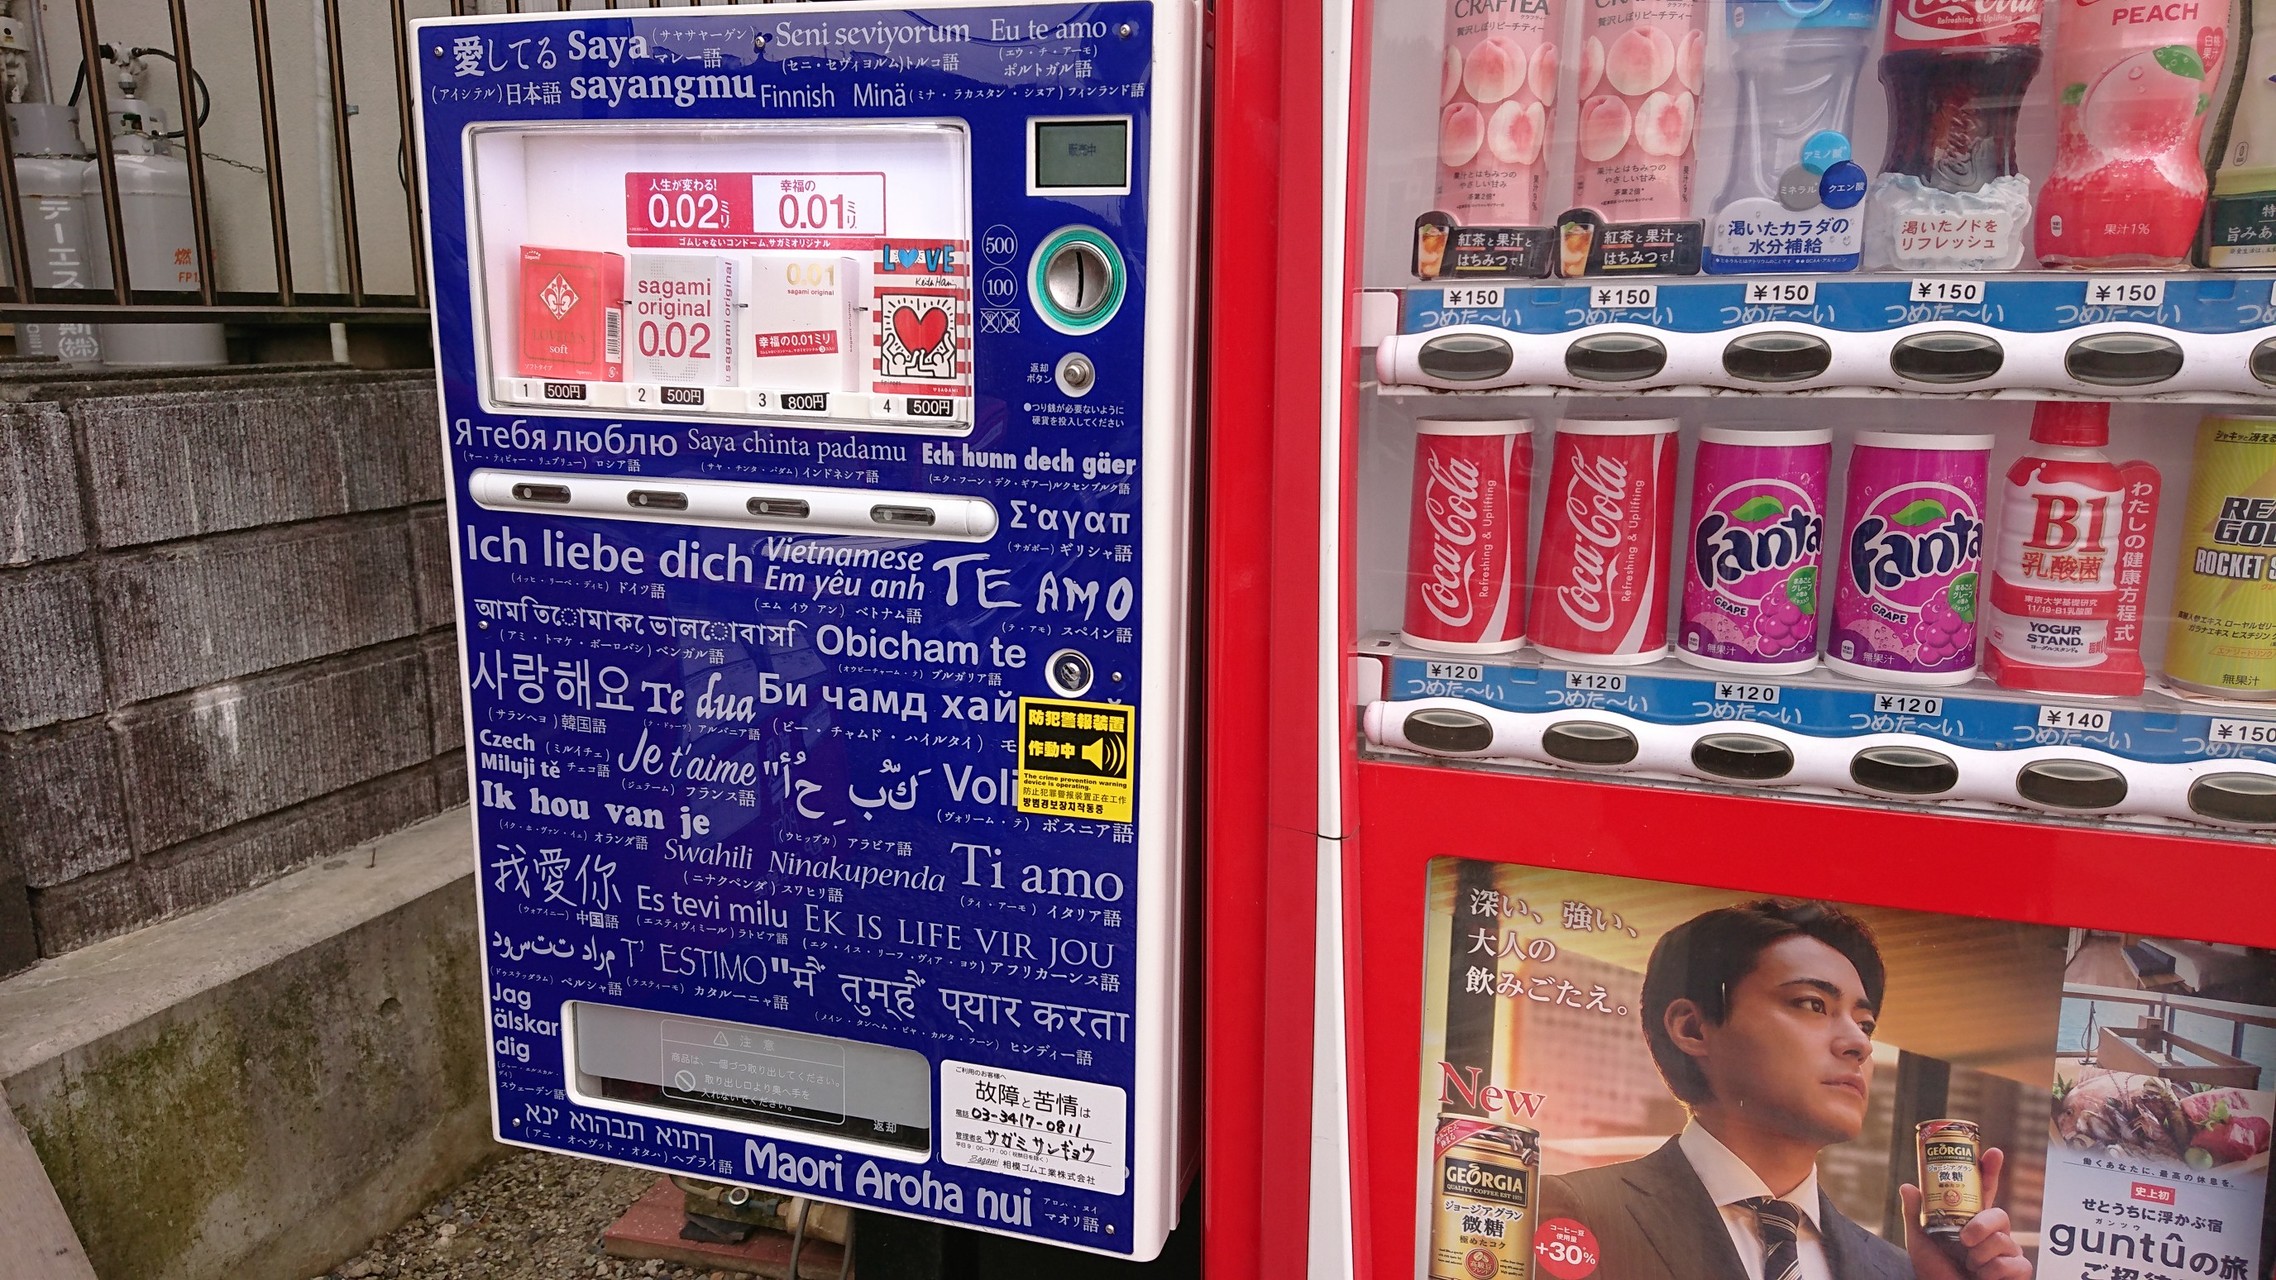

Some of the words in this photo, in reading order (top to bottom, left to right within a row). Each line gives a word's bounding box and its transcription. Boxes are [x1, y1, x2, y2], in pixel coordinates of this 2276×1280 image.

[2111, 3, 2199, 27] PEACH
[775, 22, 837, 48] Seni
[843, 22, 971, 54] seviyorum
[990, 19, 1022, 42] Eu
[1028, 22, 1050, 42] te
[1055, 19, 1107, 41] amo
[453, 36, 557, 77] 愛してる
[568, 30, 649, 68] Saya
[655, 47, 723, 69] マレー語
[1003, 59, 1093, 79] ポルトガル語
[570, 73, 756, 107] sayangmu
[761, 84, 835, 108] Finnish
[853, 83, 906, 108] Minä
[780, 179, 816, 193] 幸福の
[648, 193, 719, 229] 0.02
[778, 193, 844, 229] 0.01
[1603, 229, 1684, 246] 紅茶と果汁と
[1901, 219, 1999, 234] 渇いたノドを
[2103, 223, 2151, 236] 果汁1%
[985, 236, 1015, 255] 500
[1457, 232, 1534, 248] 紅茶と果汁と
[1748, 238, 1824, 255] 水分補給
[1901, 237, 1996, 252] リフレッシュ
[786, 263, 836, 288] 0.01
[638, 277, 712, 298] sagami
[986, 278, 1014, 297] 100
[1448, 288, 1500, 306] ¥150
[1597, 288, 1652, 306] ¥150
[1753, 285, 1810, 302] ¥150
[1917, 282, 1977, 300] ¥150
[2095, 284, 2157, 302] ¥150
[638, 298, 712, 320] original
[550, 344, 568, 355] soft
[638, 320, 712, 360] 0.02
[1026, 373, 1053, 385] ボタン
[1030, 362, 1049, 373] 返却
[522, 383, 529, 398] 1
[546, 384, 581, 400] 500円
[638, 387, 646, 403] 2
[666, 389, 702, 404] 500円
[758, 392, 767, 408] 3
[788, 394, 825, 411] 800円
[882, 398, 892, 414] 4
[913, 400, 951, 416] 500円
[455, 418, 473, 446] Я
[476, 419, 547, 451] тебя
[553, 423, 678, 457] люблю
[688, 428, 736, 458] Saya
[743, 430, 811, 457] chinta
[817, 434, 908, 464] padamu
[596, 458, 641, 473] ロシア語
[922, 441, 955, 466] Ech
[962, 442, 1017, 470] hunn
[1023, 446, 1075, 473] dech
[1082, 451, 1138, 481] gäer
[1629, 479, 1646, 529] Uplifting
[2023, 493, 2110, 554] B1
[467, 524, 527, 565] Ich
[543, 528, 645, 575] liebe
[659, 539, 753, 584] dich
[767, 536, 924, 571] Vietnamese
[1695, 504, 1823, 591] Fanta
[1850, 508, 1984, 598] Fanta
[2022, 552, 2103, 583] 乳酸菌
[2114, 481, 2154, 643] わたしの健康方程式
[2194, 549, 2265, 580] ROCKET
[764, 565, 805, 592] Em
[812, 568, 861, 601] yêu
[870, 574, 926, 601] anh
[932, 553, 1022, 609] TE
[1036, 570, 1134, 622] AMO
[1714, 596, 1748, 617] GRAPE
[1870, 602, 1908, 624] GRAPE
[1061, 626, 1133, 643] スペイン語
[2030, 621, 2082, 636] YOGUR
[816, 624, 979, 666] Obicham
[989, 636, 1027, 669] te
[1707, 641, 1737, 656] 無果汁
[1861, 650, 1896, 665] 無果汁
[471, 649, 635, 712] 사랑해요
[931, 669, 1002, 686] ブルガリア語
[1430, 664, 1479, 680] ¥120
[1570, 673, 1622, 690] ¥120
[2222, 674, 2260, 687] 無果汁
[640, 680, 685, 716] Te
[695, 671, 757, 725] dua
[758, 672, 808, 707] Би
[822, 684, 928, 724] чамд
[1720, 684, 1775, 701] ¥120
[1880, 696, 1937, 714] ¥120
[1028, 709, 1125, 733] 防犯警報装置
[2046, 710, 2104, 729] ¥140
[479, 728, 535, 751] Czech
[617, 727, 664, 774] Je
[1028, 739, 1076, 759] 作動中
[480, 752, 536, 780] Miluji
[540, 760, 561, 779] tě
[1023, 779, 1047, 787] device
[1038, 774, 1059, 782] crime
[1059, 776, 1097, 786] prevention
[1099, 780, 1128, 789] warning
[480, 780, 516, 811] Ik
[529, 787, 591, 821] hou
[604, 802, 665, 831] van
[680, 806, 711, 840] je
[664, 838, 753, 870] Swahili
[769, 850, 946, 892] Ninakupenda
[950, 842, 1006, 890] Ti
[1021, 864, 1125, 902] amo
[491, 844, 622, 911] 我愛你
[637, 885, 665, 913] Es
[672, 890, 721, 920] tevi
[729, 899, 789, 929] milu
[576, 910, 620, 929] 中国語
[803, 903, 848, 937] EK
[856, 913, 883, 941] IS
[897, 918, 962, 951] LIFE
[973, 927, 1039, 961] VIR
[1048, 937, 1116, 970] JOU
[1467, 927, 1556, 963] 大人の
[659, 942, 767, 985] ESTIMO
[491, 982, 532, 1010] Jag
[1465, 965, 1629, 1016] 飲みごたえ。
[493, 1007, 559, 1037] älskar
[496, 1035, 531, 1063] dig
[975, 1080, 1092, 1118] 故障と苦情は
[1437, 1060, 1547, 1119] New
[1927, 1144, 1973, 1158] GEORGIA
[744, 1139, 843, 1195] Maori
[856, 1160, 964, 1215] Aroha
[976, 1187, 1032, 1227] nui
[1446, 1163, 1524, 1194] GEORGIA
[2135, 1186, 2170, 1202] 史上初
[1461, 1214, 1505, 1239] 微糖
[2082, 1198, 2224, 1234] せとうちに浮かぶ宿
